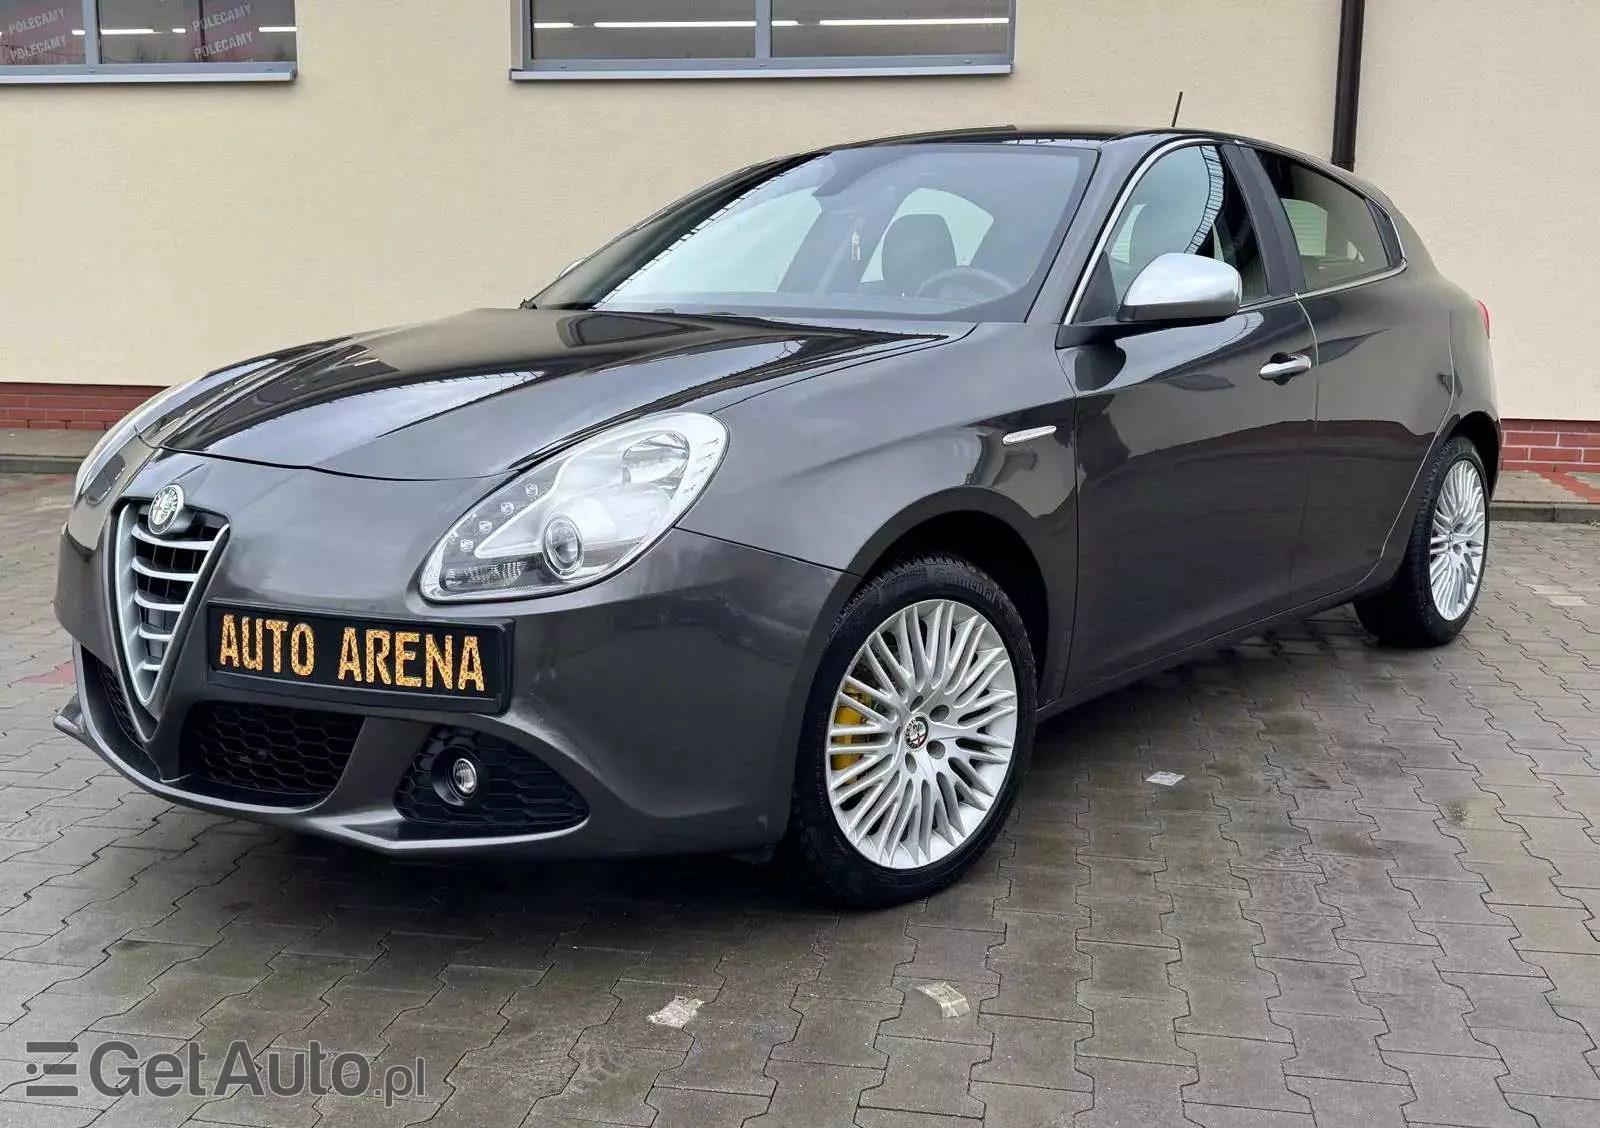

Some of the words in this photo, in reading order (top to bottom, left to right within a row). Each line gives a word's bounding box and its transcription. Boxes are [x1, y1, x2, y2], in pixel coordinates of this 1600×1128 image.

[8, 7, 65, 35] POLECAMY
[192, 3, 251, 32] POLECAMY
[10, 34, 66, 61] POLECAMY
[194, 30, 253, 60] POLECAMY
[219, 613, 316, 677] AUTO
[337, 626, 485, 691] ARENA
